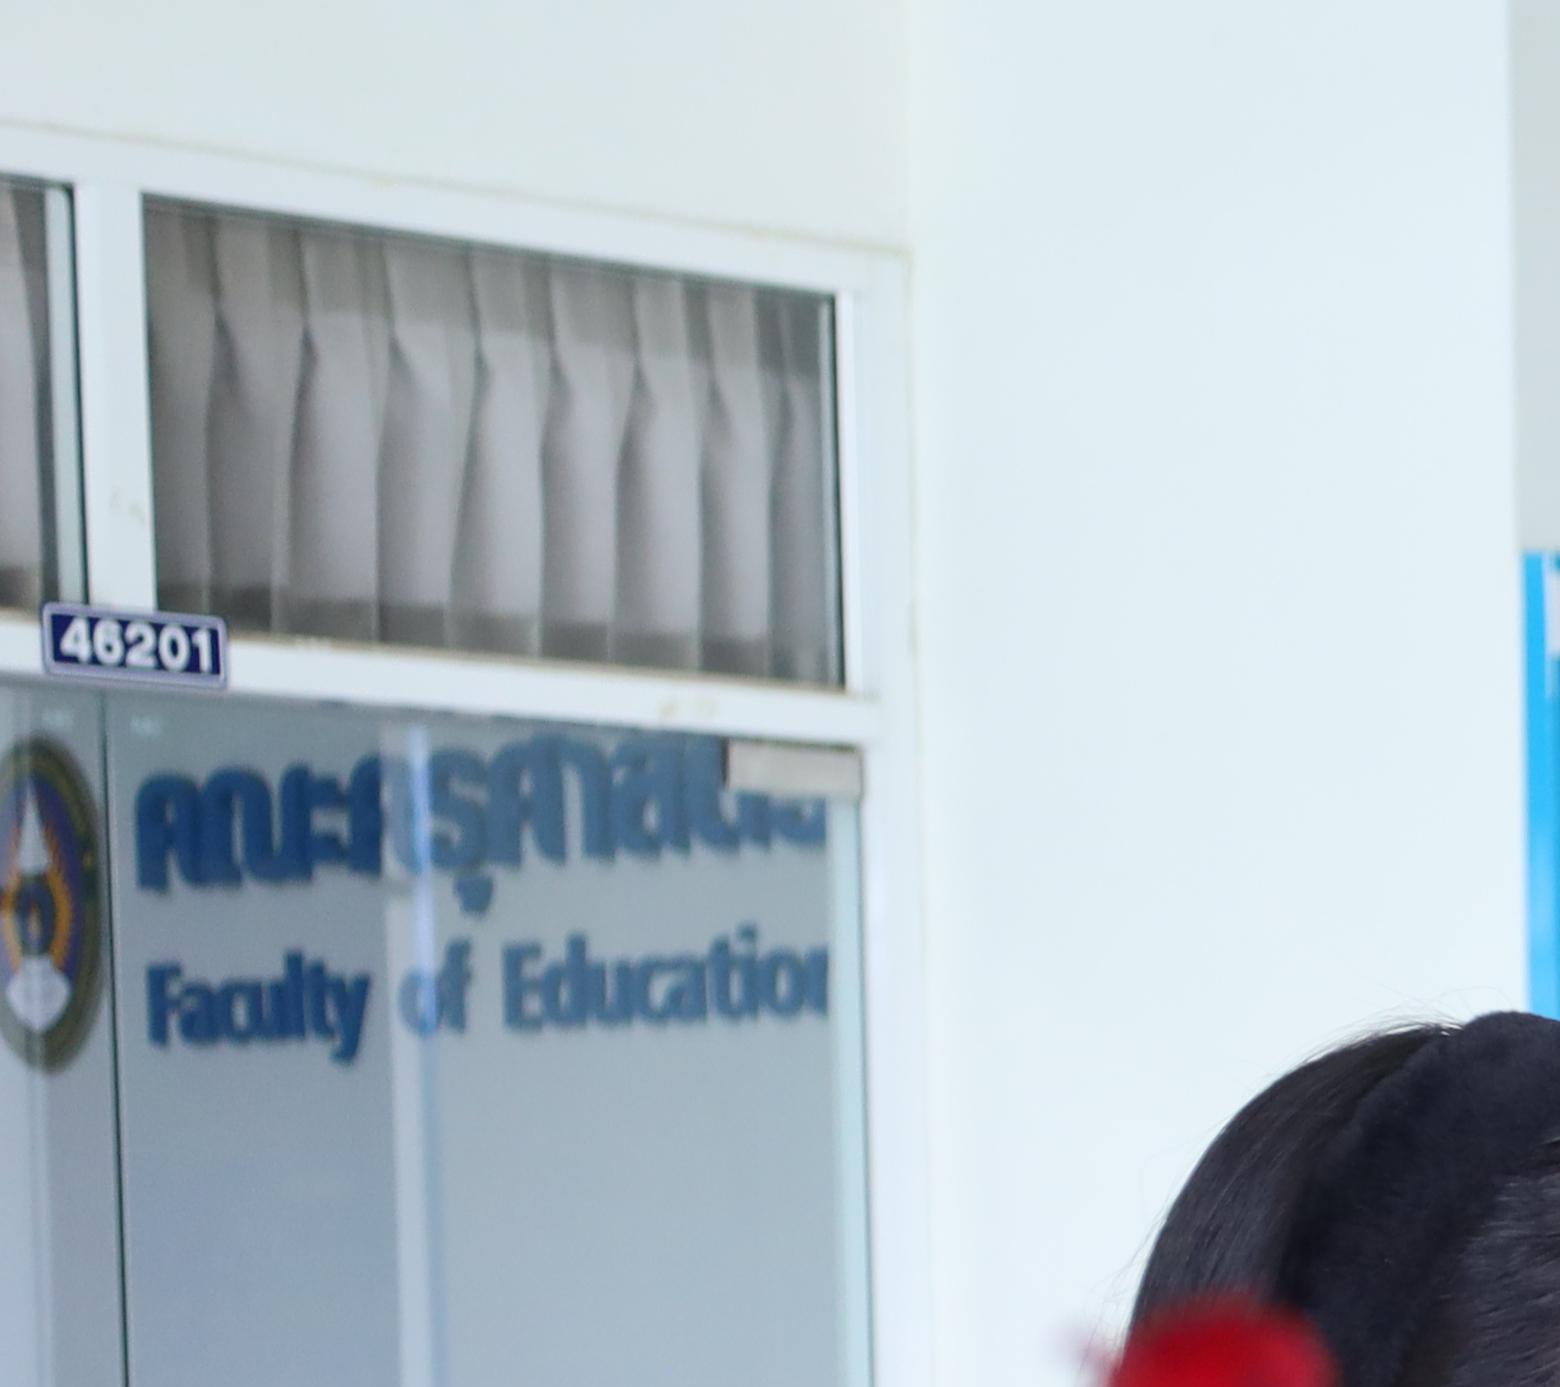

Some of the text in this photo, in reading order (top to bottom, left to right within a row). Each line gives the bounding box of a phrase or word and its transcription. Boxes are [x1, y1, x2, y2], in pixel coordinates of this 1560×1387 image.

[59, 615, 214, 674] 46201
[146, 949, 372, 1066] Faculty
[398, 937, 474, 1038] of
